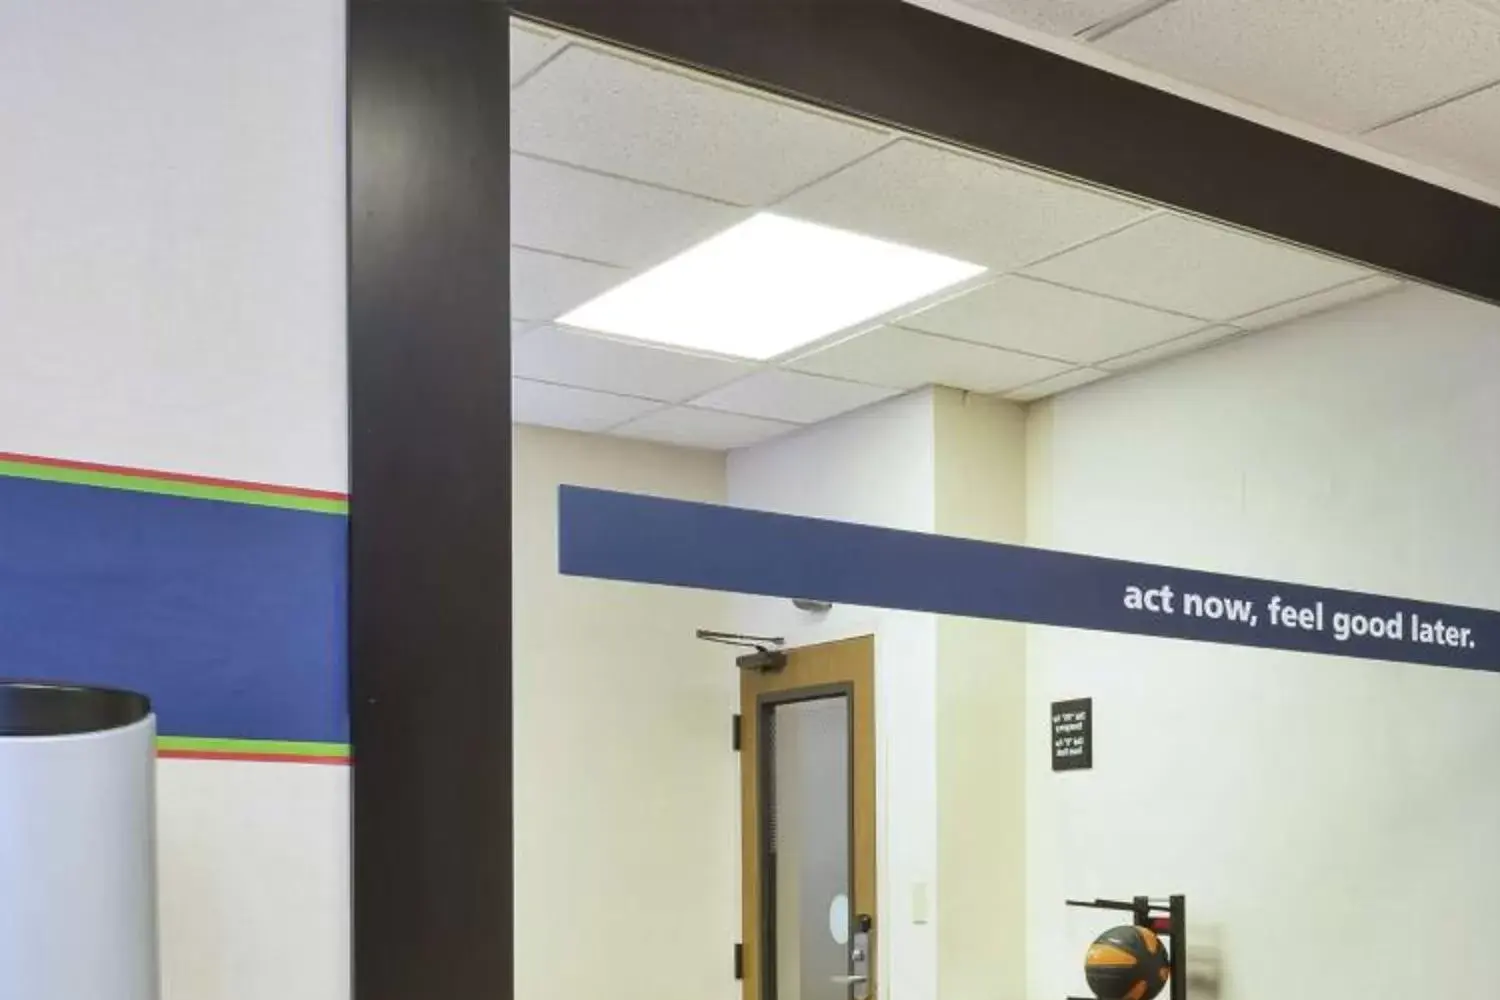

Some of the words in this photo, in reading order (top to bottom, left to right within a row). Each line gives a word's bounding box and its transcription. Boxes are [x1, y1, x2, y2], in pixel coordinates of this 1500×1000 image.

[1123, 584, 1174, 614] act
[1183, 593, 1258, 627] now,
[1268, 597, 1324, 631] feel
[1333, 612, 1403, 641] good
[1412, 614, 1476, 649] later.
